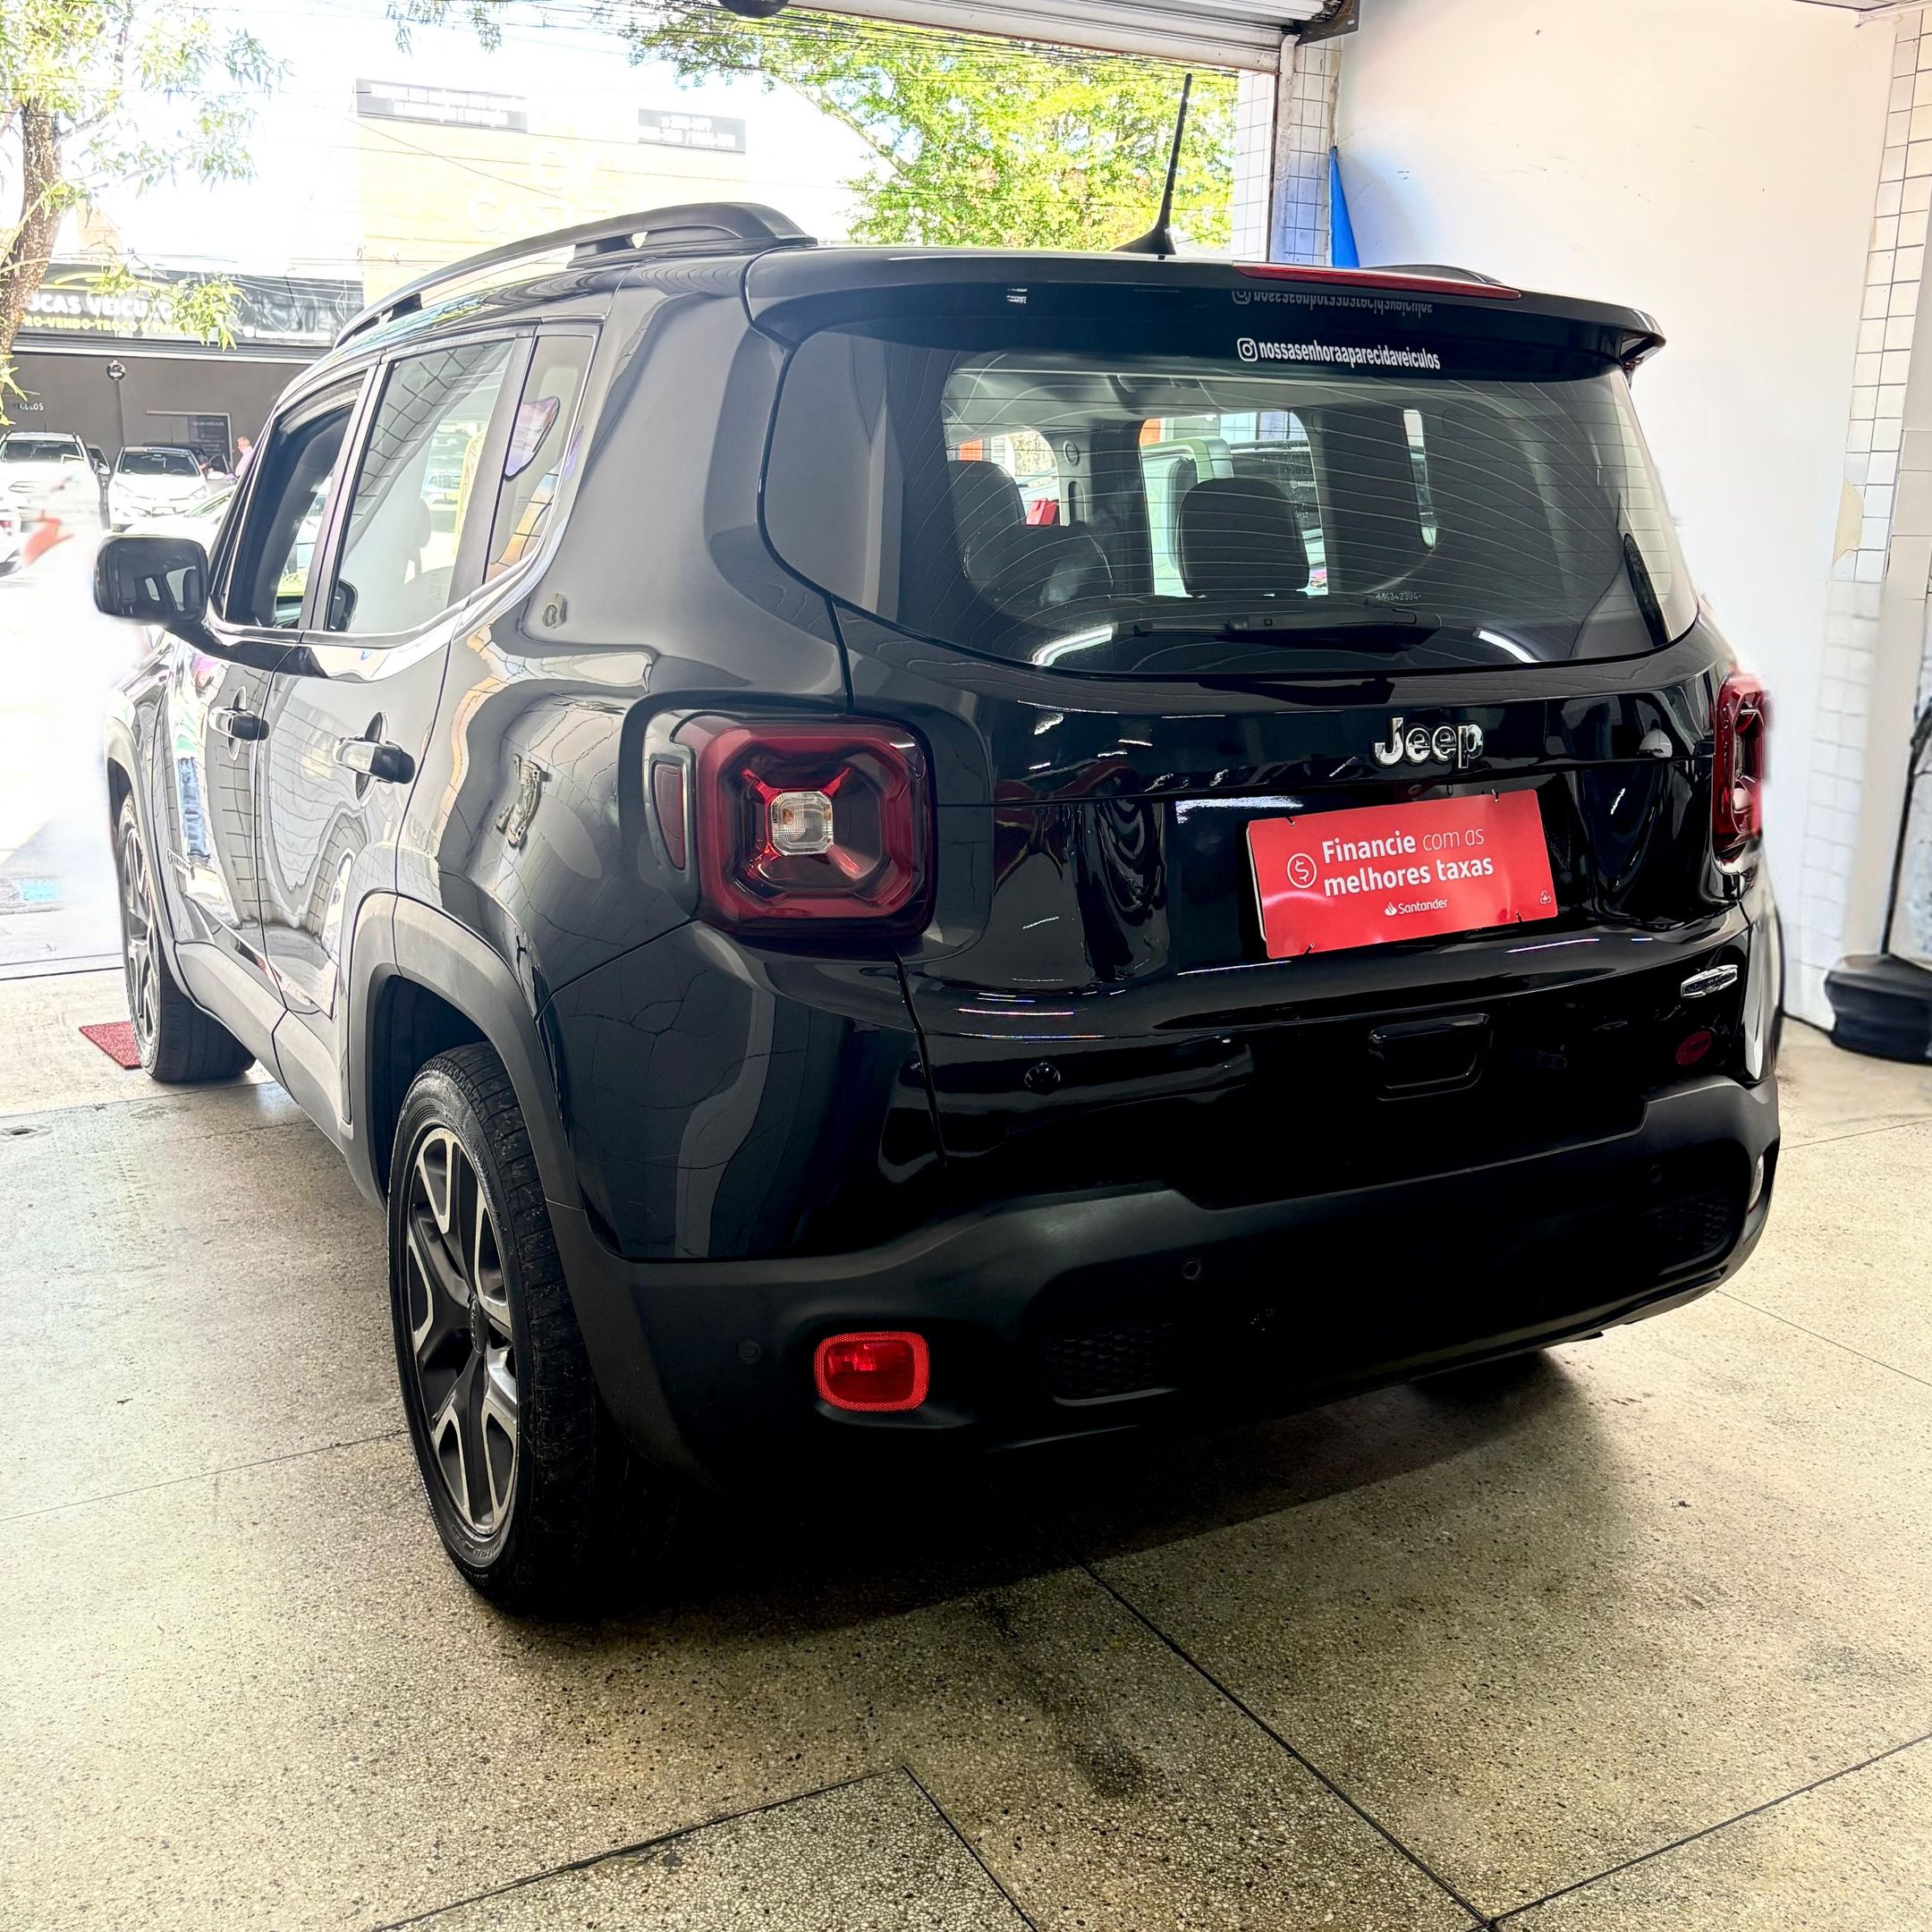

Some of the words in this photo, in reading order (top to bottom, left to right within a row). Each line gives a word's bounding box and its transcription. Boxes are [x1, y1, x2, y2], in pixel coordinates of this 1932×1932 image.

[27, 293, 82, 314] UCAS
[1258, 339, 1441, 369] nossasenhoraaparecidaveiculos
[1374, 717, 1484, 769] Jeep
[1322, 830, 1417, 864] Financie
[1422, 831, 1460, 851] com
[1464, 828, 1485, 846] as
[1324, 865, 1431, 896] melhores
[1436, 857, 1495, 881] taxas
[1398, 898, 1449, 915] Santander
